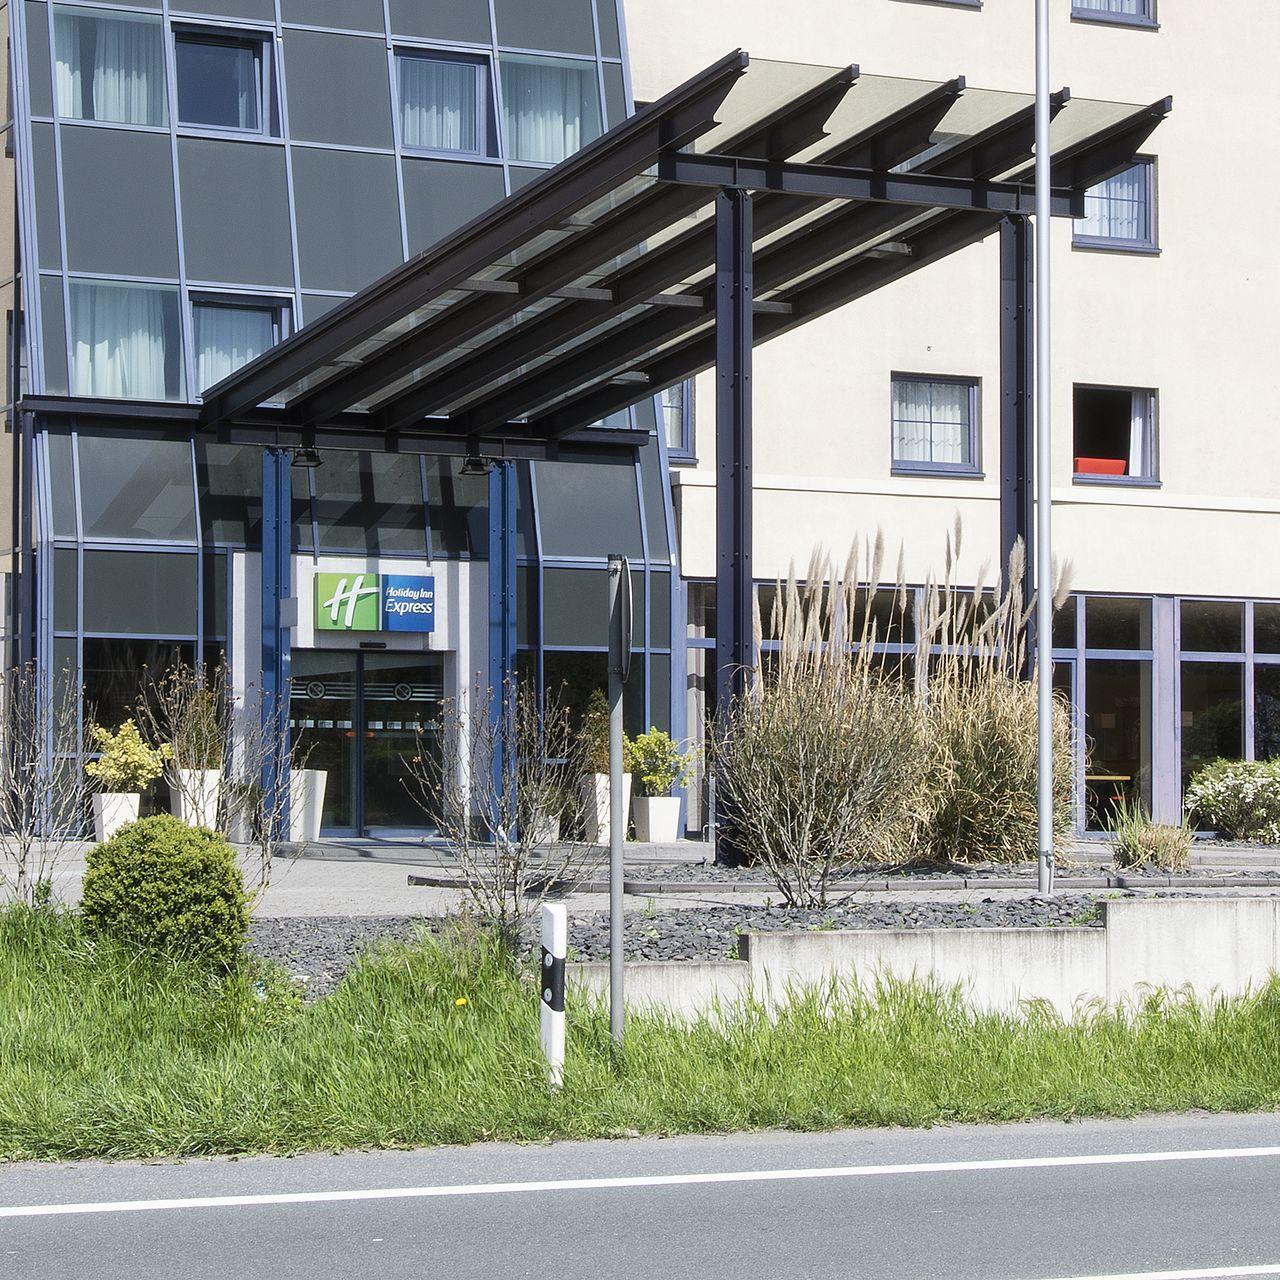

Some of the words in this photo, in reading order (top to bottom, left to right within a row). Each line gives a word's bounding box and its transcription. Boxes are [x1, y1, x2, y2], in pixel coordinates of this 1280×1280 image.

[385, 586, 420, 600] Holiday
[419, 587, 433, 599] Inn
[385, 598, 433, 616] Express
